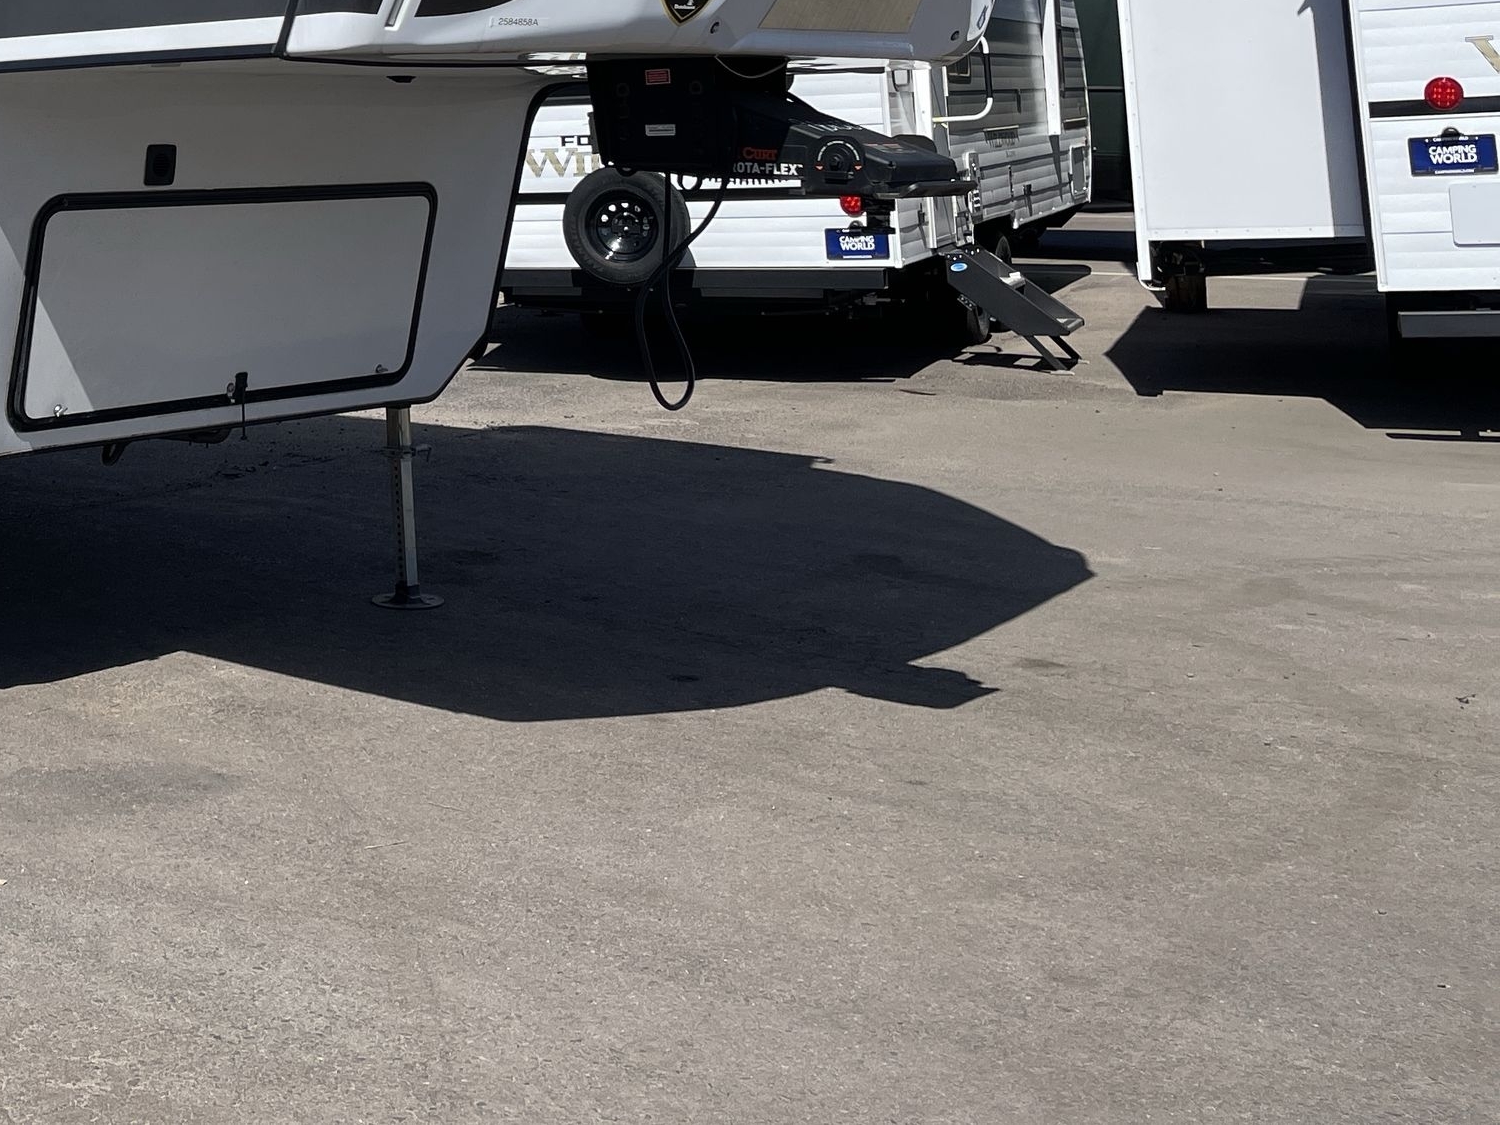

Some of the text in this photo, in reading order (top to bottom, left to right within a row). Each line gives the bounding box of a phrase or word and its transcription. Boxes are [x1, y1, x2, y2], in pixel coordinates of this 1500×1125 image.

[1429, 145, 1476, 155] CAMPING
[1430, 154, 1478, 164] WORLD
[840, 242, 876, 251] WORLD
